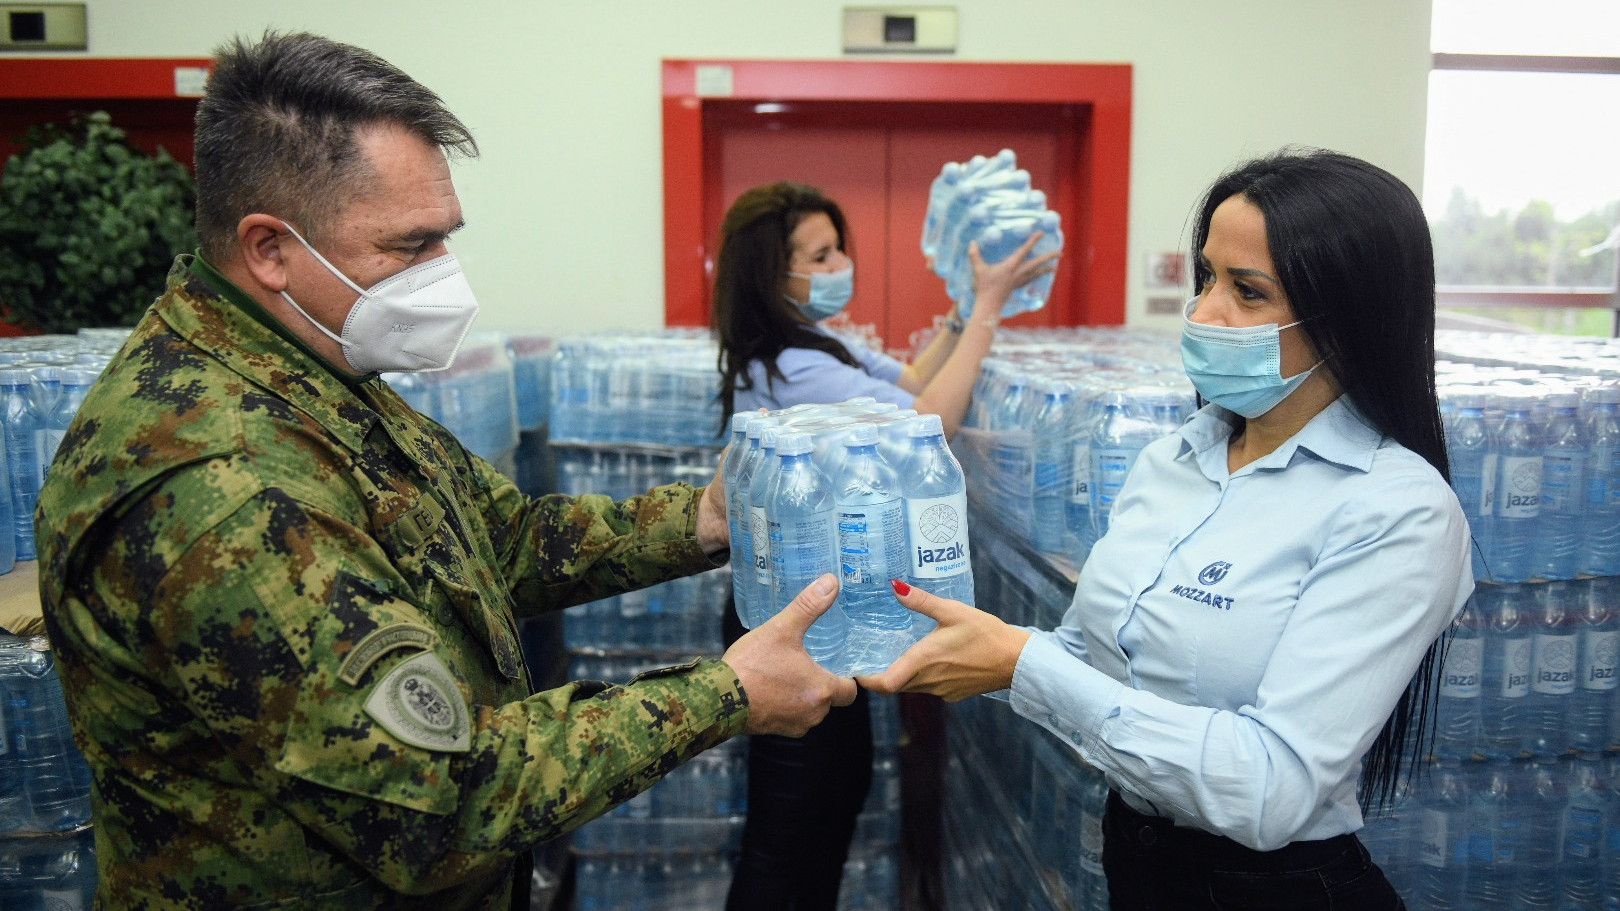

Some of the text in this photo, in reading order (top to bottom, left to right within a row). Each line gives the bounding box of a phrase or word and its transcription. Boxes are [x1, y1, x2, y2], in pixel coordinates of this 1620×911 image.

[1505, 492, 1538, 509] jaza
[917, 541, 965, 568] jazak
[1169, 584, 1235, 611] MOZZART
